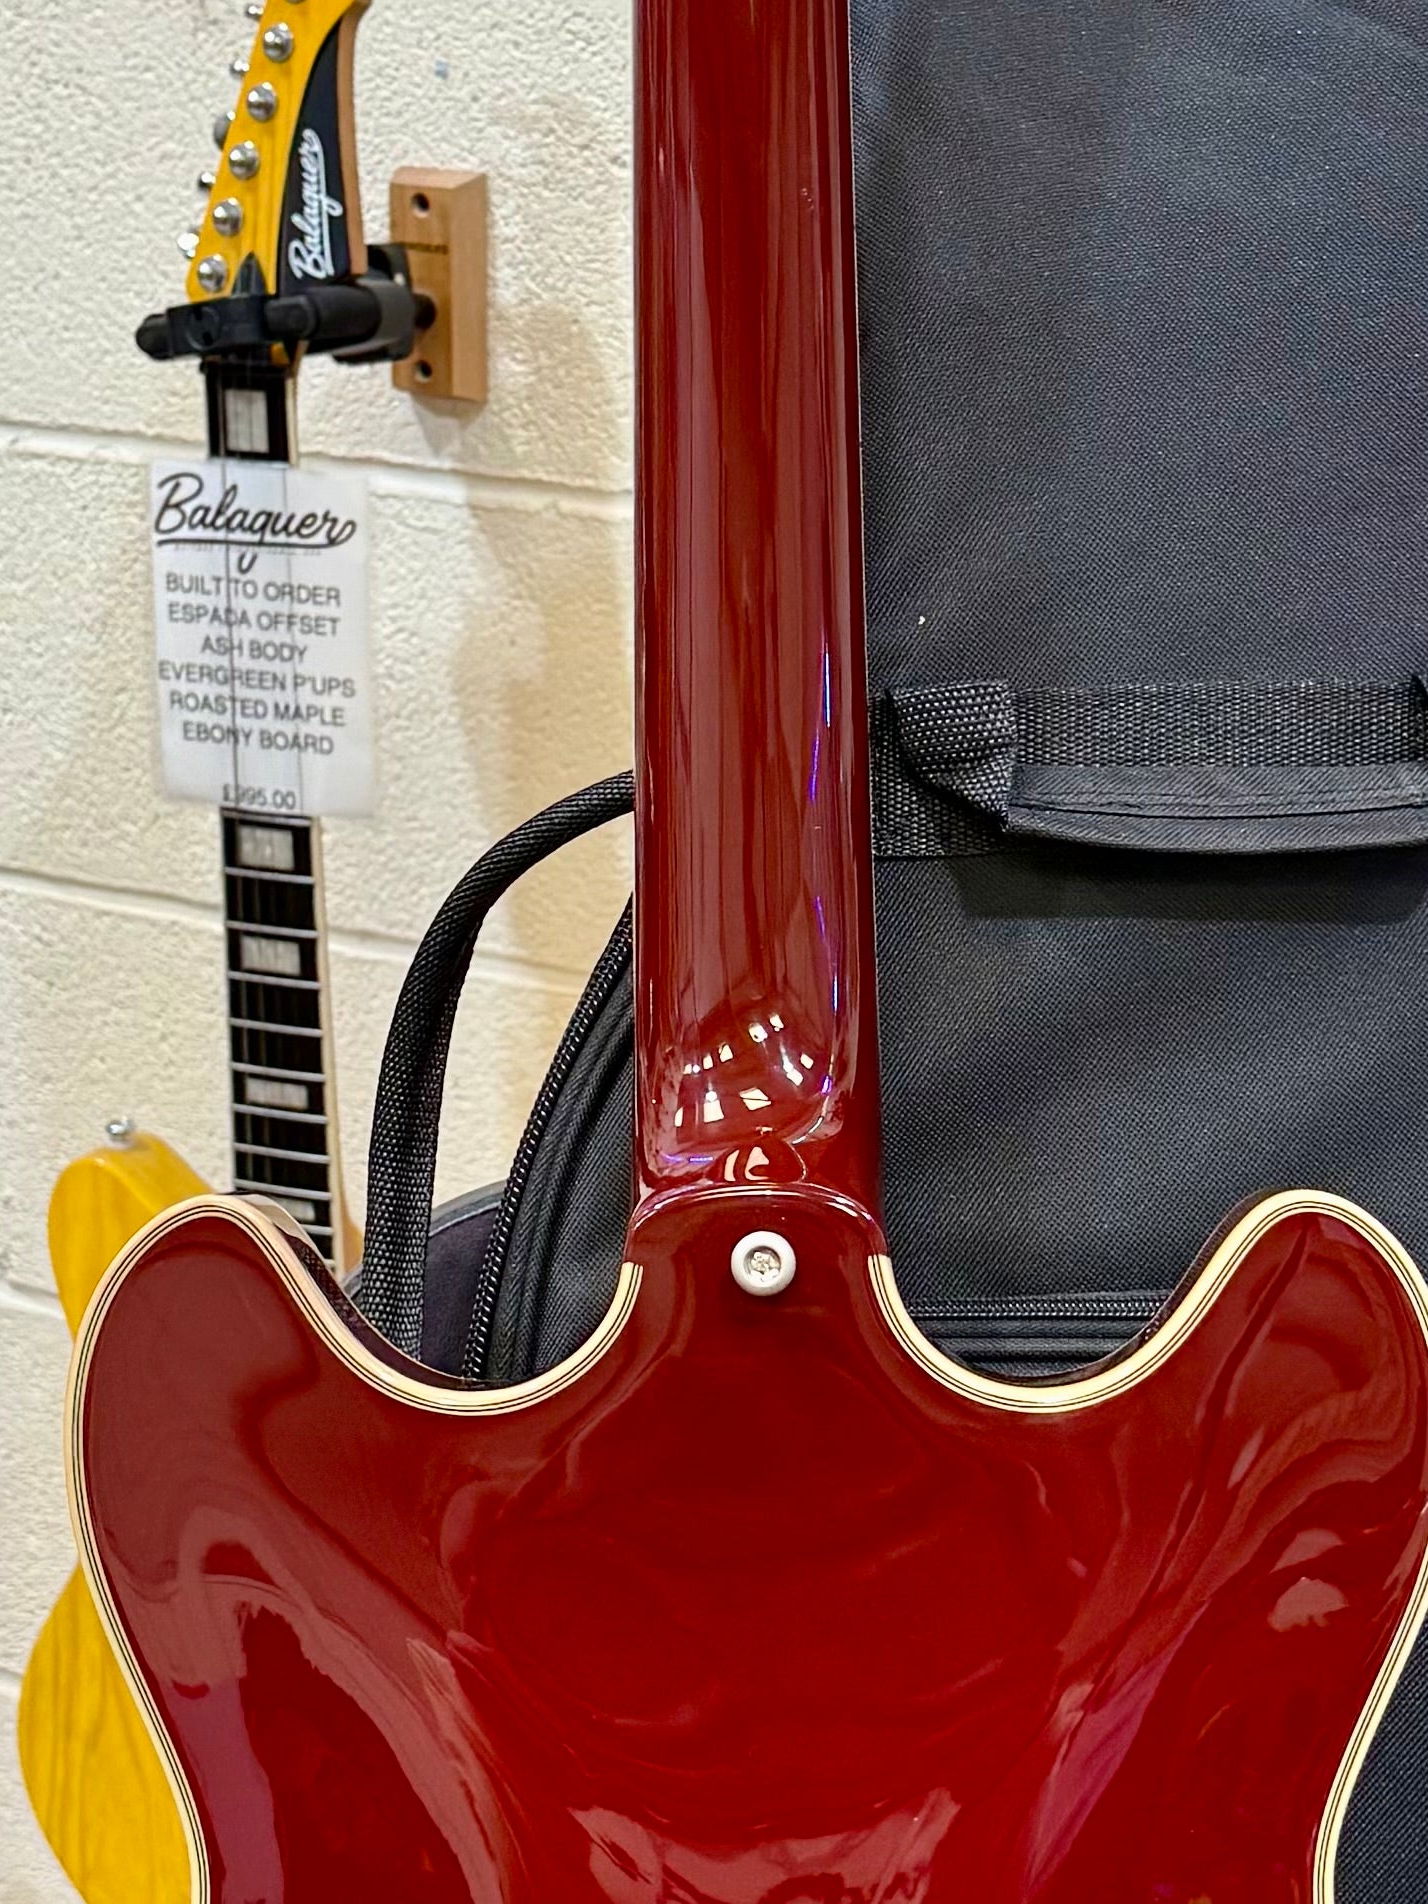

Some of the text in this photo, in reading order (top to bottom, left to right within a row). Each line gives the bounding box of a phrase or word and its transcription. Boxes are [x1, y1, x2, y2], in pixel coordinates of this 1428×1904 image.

[155, 472, 356, 574] Balaguer
[165, 572, 341, 607] BUILT TO ORDER
[167, 603, 341, 637] ESPADA OFFSET
[200, 635, 307, 663] ASH BODY
[158, 660, 287, 692] EVERGREEN
[169, 690, 346, 728] ROASTED MAPLE
[182, 721, 335, 756] EBONY BOARD
